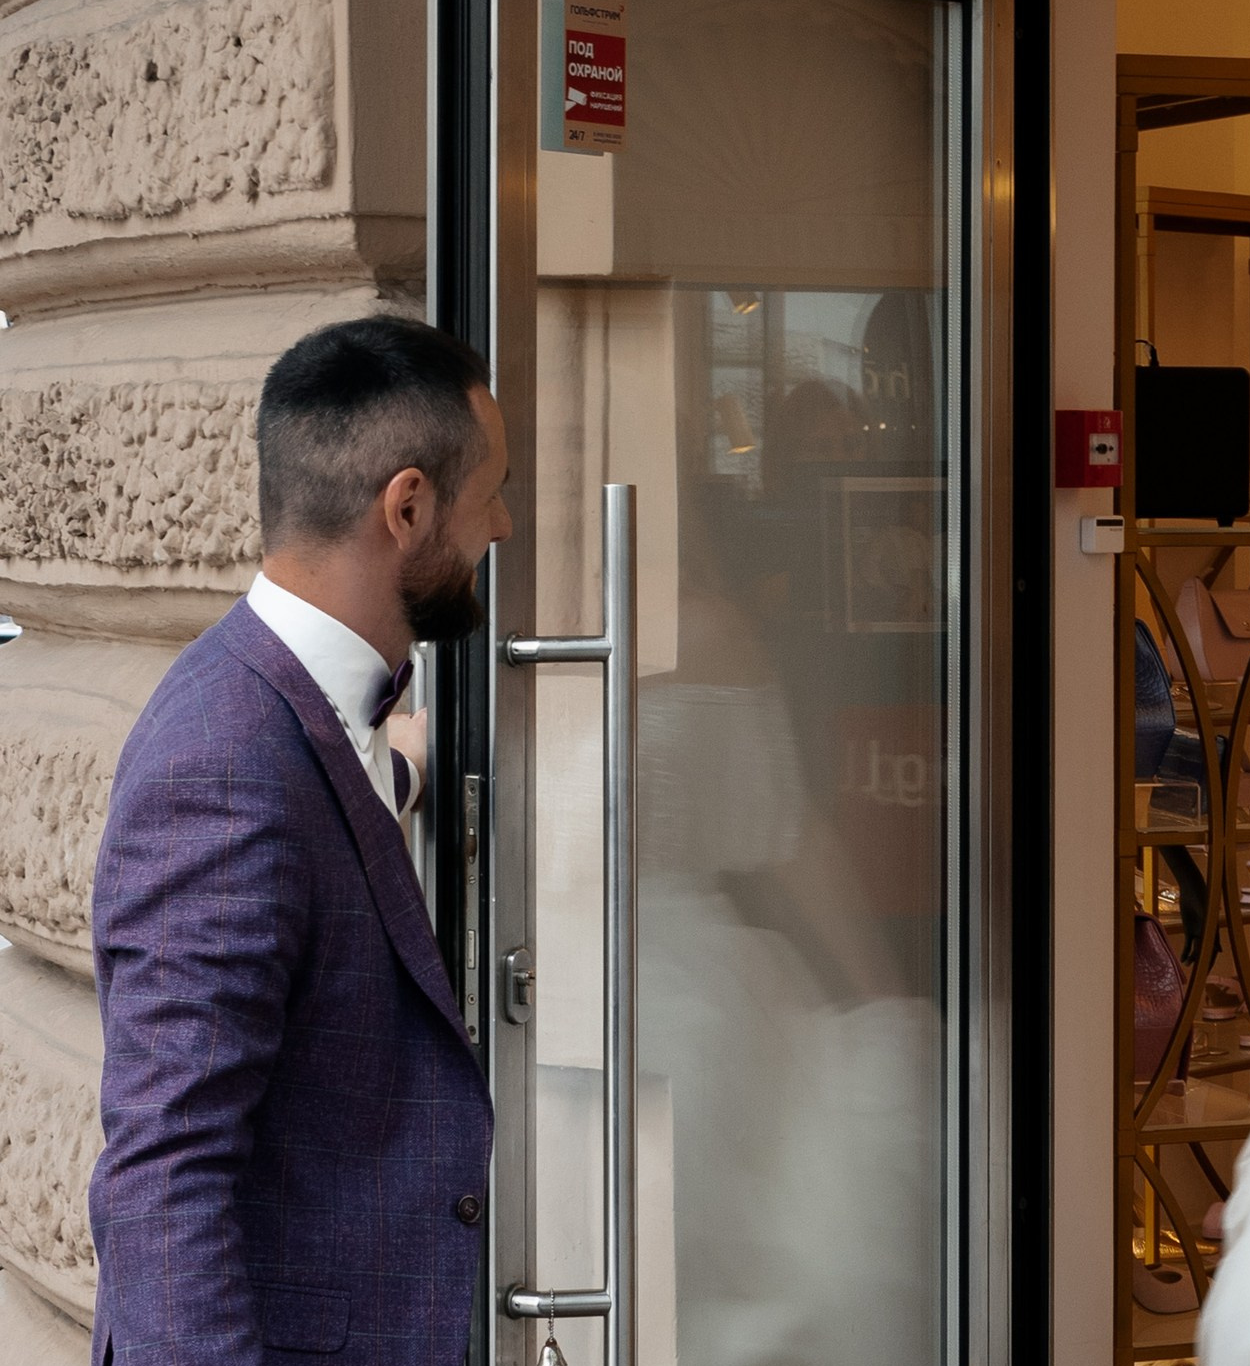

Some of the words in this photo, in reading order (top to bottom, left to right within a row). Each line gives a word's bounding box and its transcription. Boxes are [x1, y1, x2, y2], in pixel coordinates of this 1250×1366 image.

[570, 4, 621, 21] ГОЛЬФСТРИМ
[568, 40, 594, 59] ПОД
[568, 62, 623, 83] ОХРАНОЙ
[569, 129, 585, 141] 24/7
